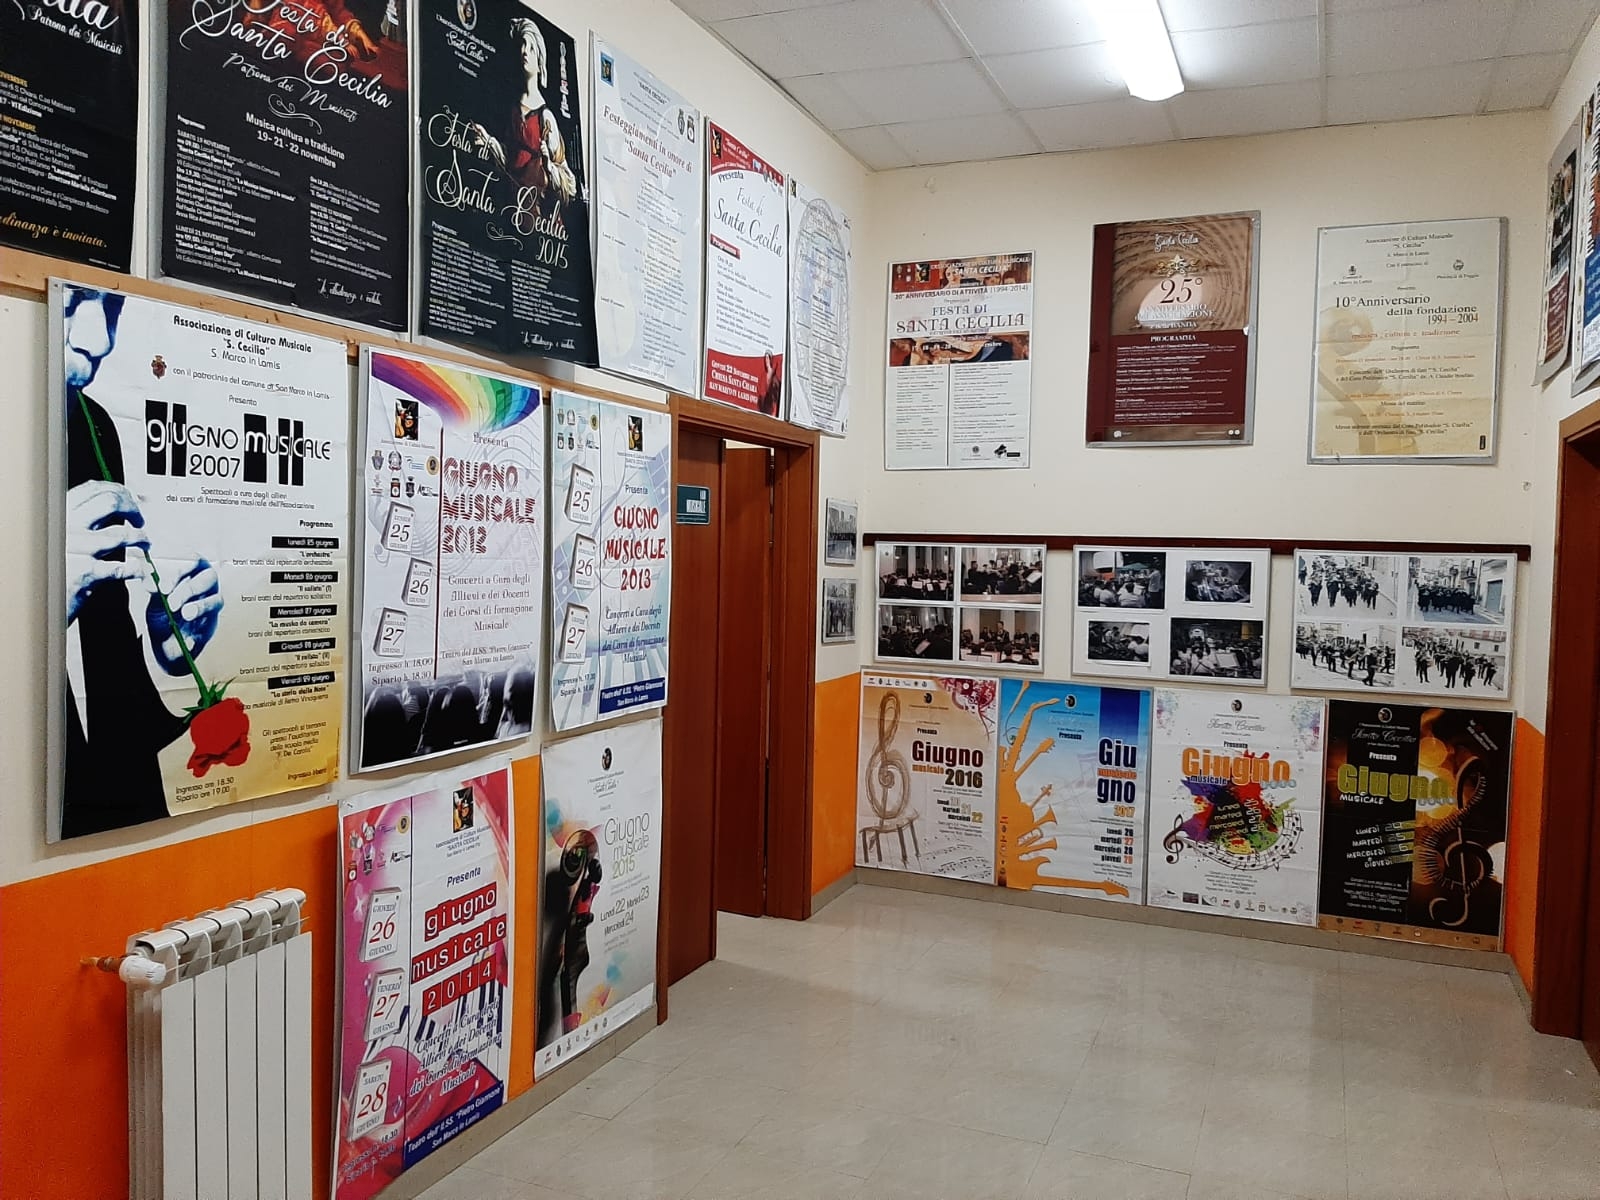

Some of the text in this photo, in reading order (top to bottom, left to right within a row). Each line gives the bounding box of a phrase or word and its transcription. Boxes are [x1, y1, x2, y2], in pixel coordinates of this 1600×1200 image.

[27, 5, 67, 33] Patrona
[68, 24, 81, 39] dei
[83, 29, 123, 55] Musicisti
[325, 25, 349, 48] di
[222, 52, 358, 123] Patrona dei Musicisti
[304, 46, 393, 110] Cecilia
[246, 112, 345, 161] Musica cultura e tradizione
[428, 105, 490, 160] Festa di
[603, 105, 692, 173] Festeggiamenti in onore di
[300, 148, 337, 169] novembre
[624, 138, 649, 163] "Santa
[718, 171, 744, 183] Presenta
[426, 149, 568, 241] Santa Cecilia
[737, 187, 754, 210] Festa
[714, 198, 745, 235] Santa
[749, 218, 783, 258] Cecilia
[62, 229, 108, 248] invitata.
[535, 238, 569, 269] 2015
[905, 290, 950, 299] ANNIVERSARIO
[1160, 277, 1203, 304] 25°
[1335, 293, 1430, 308] 10° Anniversario
[932, 304, 987, 316] FESTA DI
[1387, 305, 1477, 316] della fondazione
[1427, 313, 1479, 325] 1994 2004
[896, 313, 1024, 333] SANTA CECILIA
[174, 315, 312, 353] Associazione di Cultura Musicale
[1150, 335, 1196, 343] PROGRAMMA
[238, 341, 270, 356] Cecilia"
[222, 350, 281, 370] Marco in Lamis
[193, 369, 228, 383] patrocinio
[230, 375, 240, 385] del
[241, 380, 265, 390] comune
[275, 384, 288, 392] San
[289, 385, 306, 396] Marco
[228, 395, 257, 407] Presenta
[473, 432, 509, 448] Presenta
[189, 454, 240, 479] 2007
[443, 456, 519, 492] GIUGNO
[625, 484, 649, 495] Presenta
[443, 490, 536, 524] MUSICALE
[572, 491, 591, 513] 25
[299, 520, 333, 529] Programma
[613, 505, 660, 533] GIUGNO
[390, 523, 411, 542] 25
[442, 524, 487, 554] 2012
[315, 540, 334, 548] giugno
[605, 536, 668, 564] MUSICALE
[576, 559, 593, 576] 26
[314, 574, 333, 582] giugno
[410, 579, 430, 596] 26
[448, 574, 511, 586] Concerti Cura
[620, 568, 651, 591] 2013
[451, 588, 530, 602] Allievi dei Docenti
[313, 607, 332, 616] giugno
[443, 605, 481, 618] dei Corsi
[475, 619, 510, 632] Musicale
[383, 627, 405, 645] 27
[567, 627, 586, 650] 27
[368, 663, 402, 673] Ingresso
[371, 675, 402, 687] Sipario
[912, 740, 984, 769] Giugno
[1099, 738, 1137, 769] Giu
[1223, 740, 1249, 749] Presenta
[1369, 751, 1397, 761] Presenta
[912, 764, 944, 775] musicale
[1182, 746, 1292, 788] Giugno
[175, 784, 203, 795] Ingresso
[217, 776, 235, 787] 18.30
[945, 769, 983, 789] 2016
[1189, 774, 1228, 786] musicale
[1337, 764, 1452, 803] Giugno
[175, 793, 199, 804] Sipario
[213, 786, 231, 796] 19.00
[1097, 777, 1135, 803] gno
[1339, 793, 1384, 805] MUSICALE
[971, 811, 983, 823] 22
[1114, 805, 1136, 818] 2017
[604, 812, 650, 845] Giugno
[1124, 828, 1134, 837] 26
[1355, 824, 1380, 836] LUNEDÌ
[1100, 835, 1122, 845] martedì
[1352, 836, 1383, 847] MARTEDÌ
[1346, 848, 1386, 859] MERCOLEDÌ
[1364, 858, 1393, 868] GIOVEDÌ
[447, 866, 481, 888] Presenta
[612, 855, 636, 880] 2015
[425, 888, 497, 938] giugno
[600, 886, 650, 923] Lunedì 22 23
[369, 912, 396, 944] 26
[625, 910, 634, 926] 24
[412, 920, 506, 976] musicale
[427, 961, 493, 1011] 2014
[373, 993, 400, 1021] 27
[417, 1011, 479, 1054] Concerti Cura
[440, 1061, 477, 1096] Musicale
[356, 1082, 387, 1119] 28
